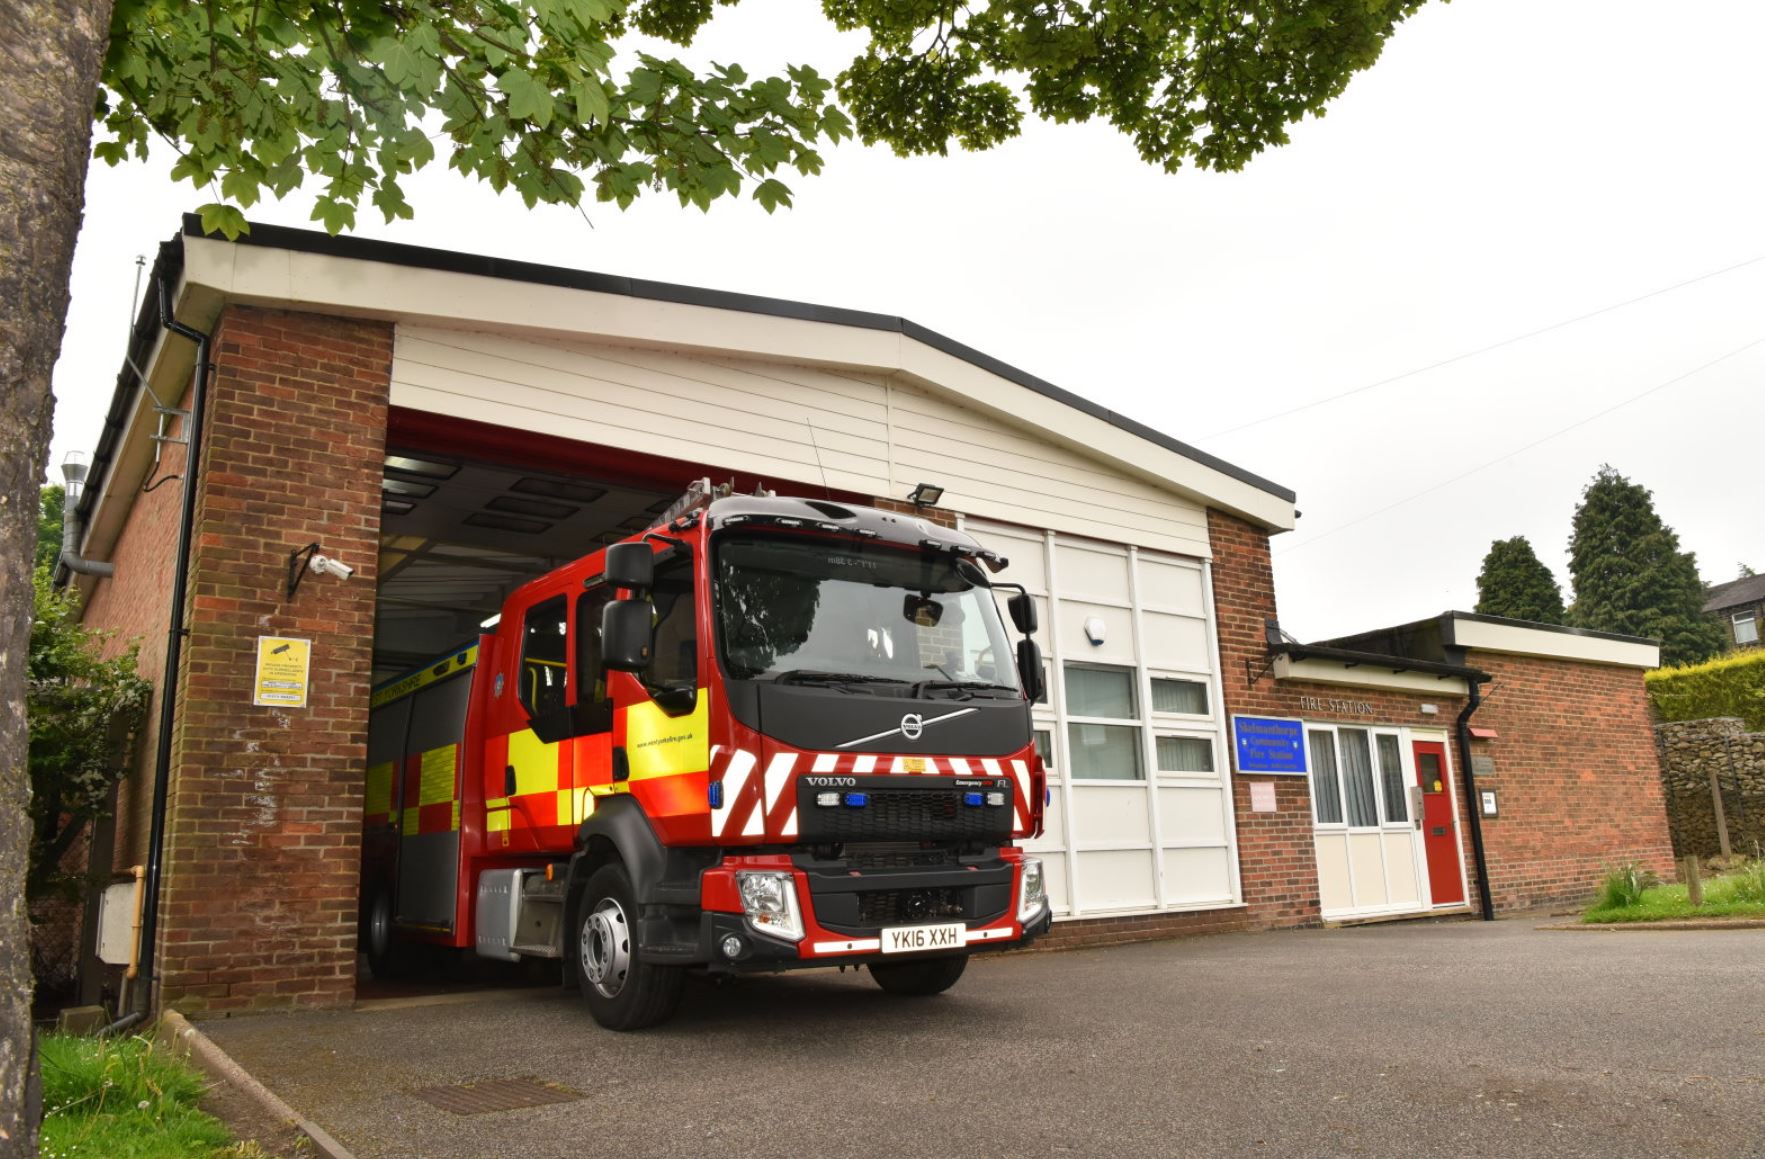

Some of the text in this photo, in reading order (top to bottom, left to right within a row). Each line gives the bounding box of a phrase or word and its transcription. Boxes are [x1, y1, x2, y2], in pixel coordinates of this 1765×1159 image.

[1300, 696, 1374, 714] FIRE STATION
[805, 777, 856, 787] VOLVO
[891, 927, 957, 949] YK16 XXH
